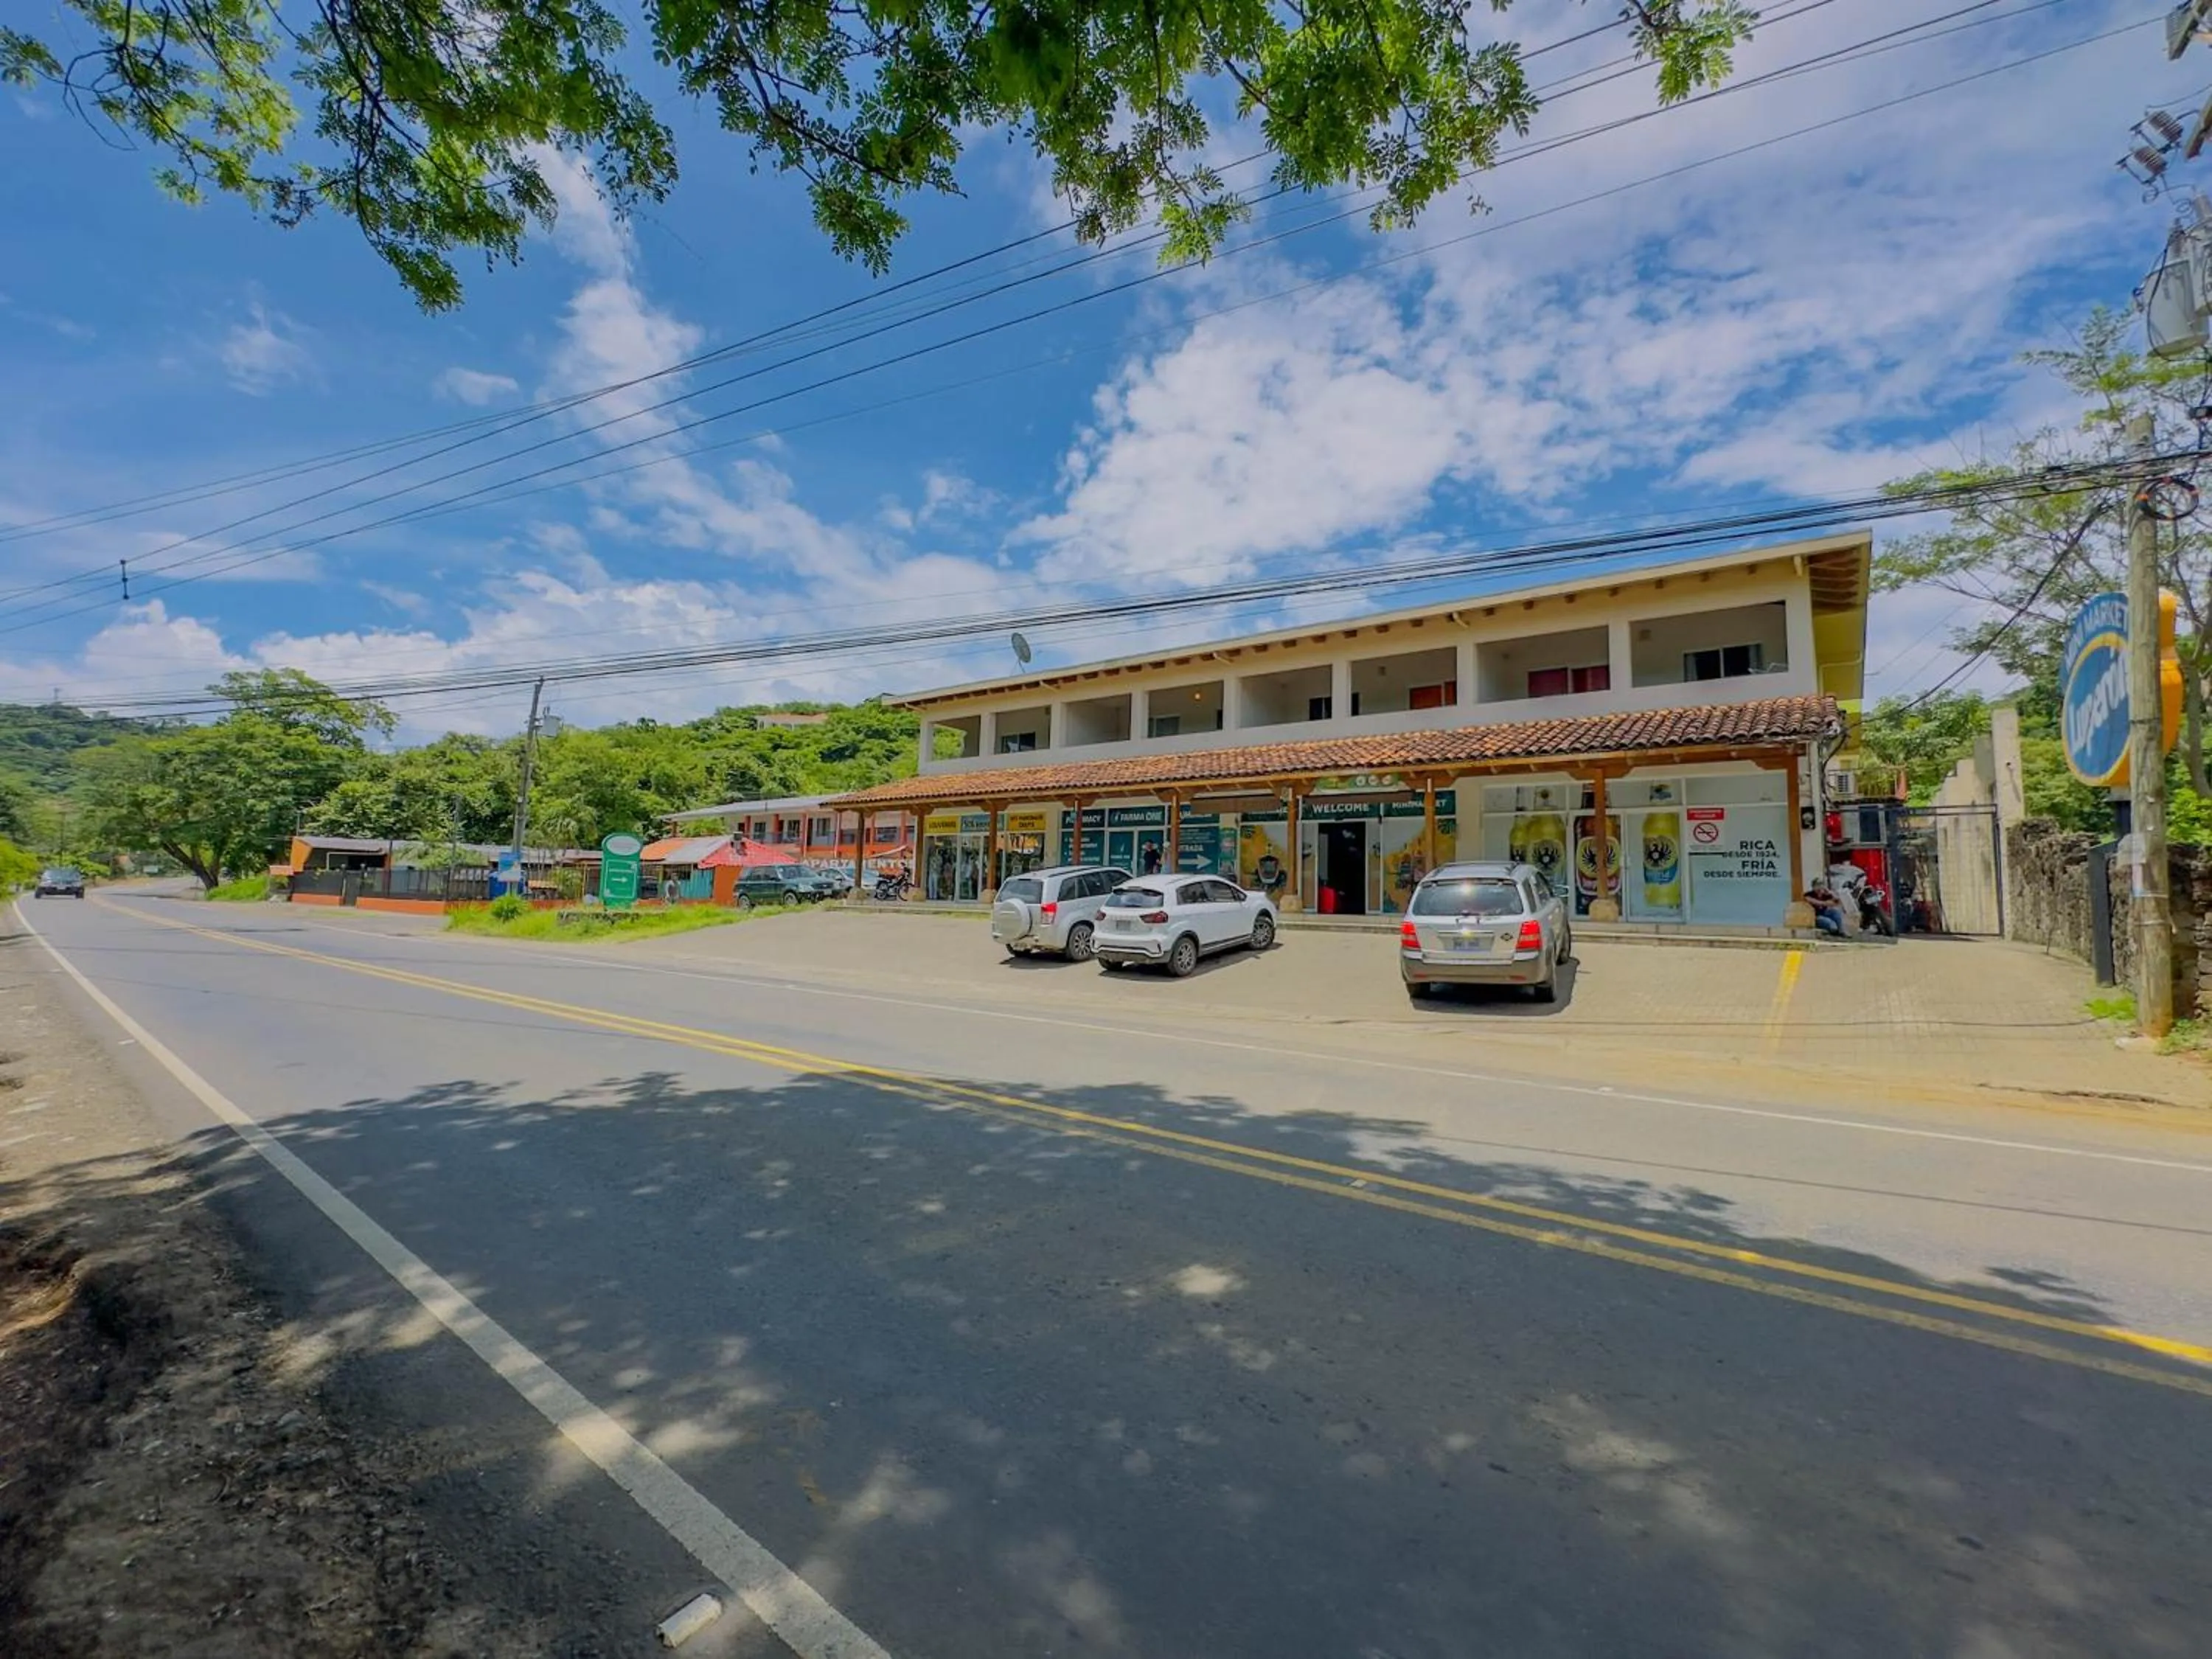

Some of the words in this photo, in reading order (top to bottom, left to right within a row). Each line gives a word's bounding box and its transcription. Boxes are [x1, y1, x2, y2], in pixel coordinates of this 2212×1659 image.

[1312, 802, 1370, 813] WELCOME
[1121, 813, 1145, 822] FARMA
[1146, 811, 1163, 821] ONE
[1739, 840, 1775, 850] RICA
[1741, 858, 1776, 870] FRÍA
[1703, 870, 1734, 878] DESDE
[1736, 870, 1782, 879] SIEMPRE.
